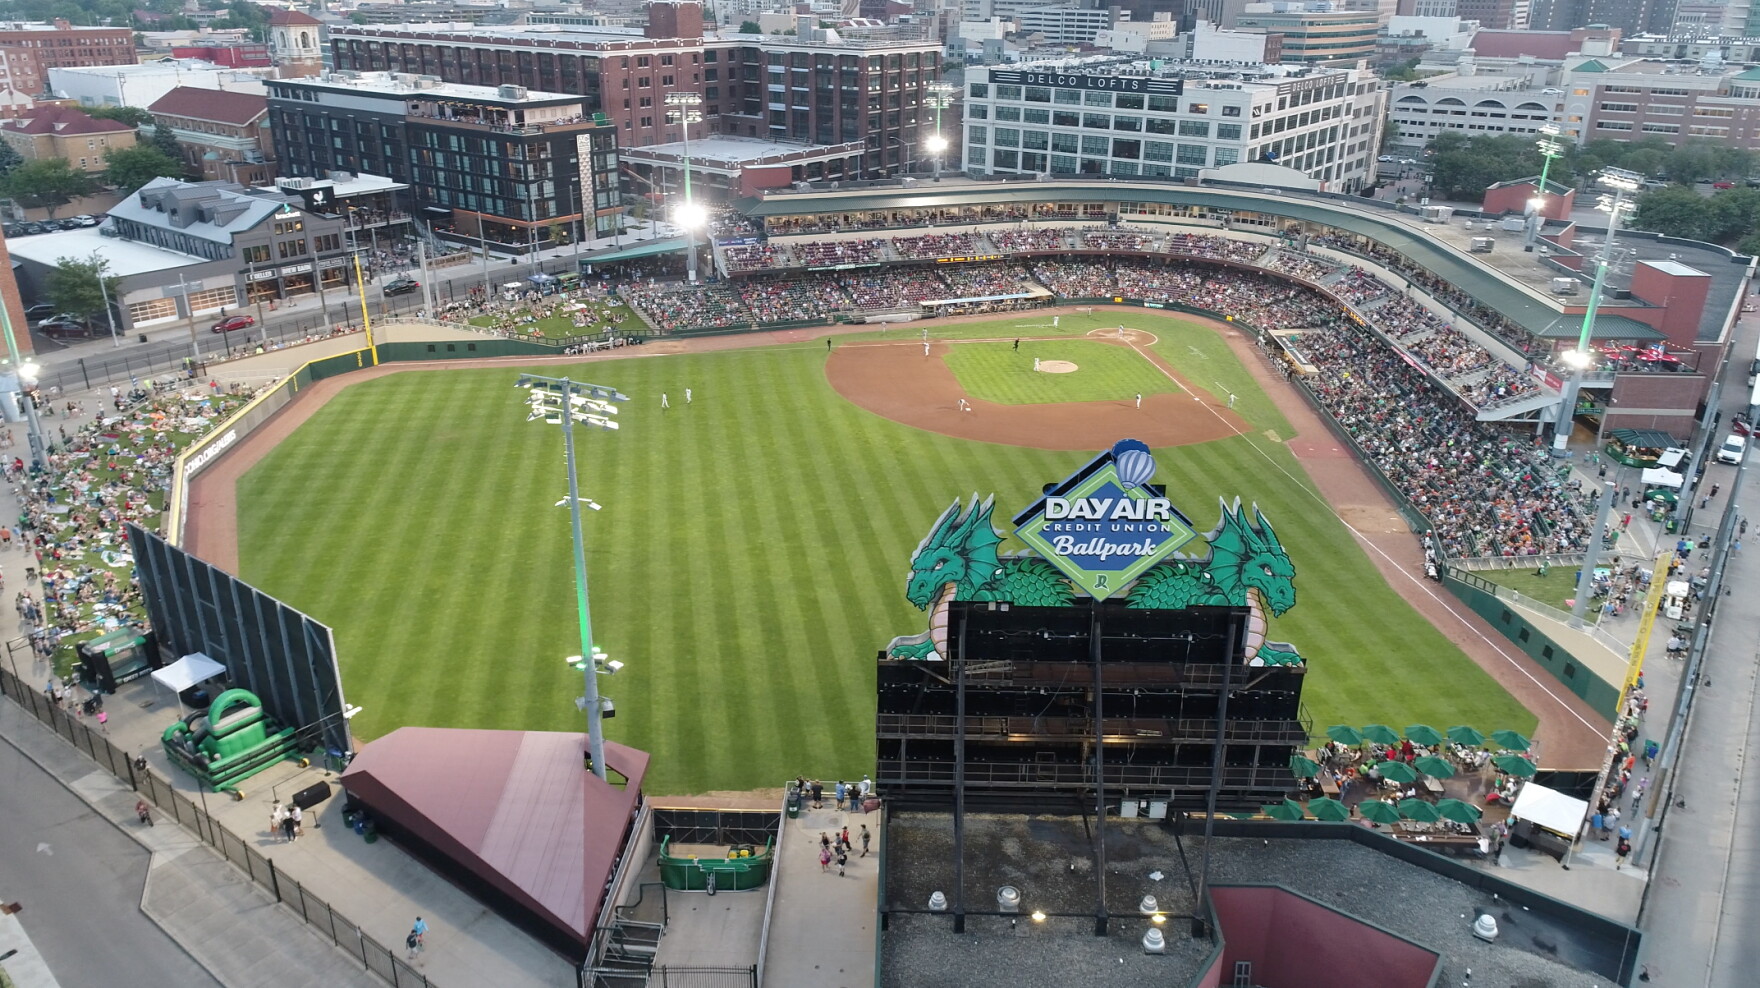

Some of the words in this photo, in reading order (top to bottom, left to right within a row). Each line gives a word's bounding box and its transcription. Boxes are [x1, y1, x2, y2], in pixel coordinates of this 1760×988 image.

[1028, 74, 1077, 86] DELCO
[1087, 78, 1139, 90] LOFTS
[1292, 81, 1312, 91] DELCO
[1316, 77, 1334, 87] LOFTS
[1044, 497, 1111, 522] DAY
[1111, 497, 1171, 522] AIR
[1043, 523, 1101, 532] CREDIT
[1111, 523, 1171, 532] UNION
[1053, 535, 1157, 561] Ballpark
